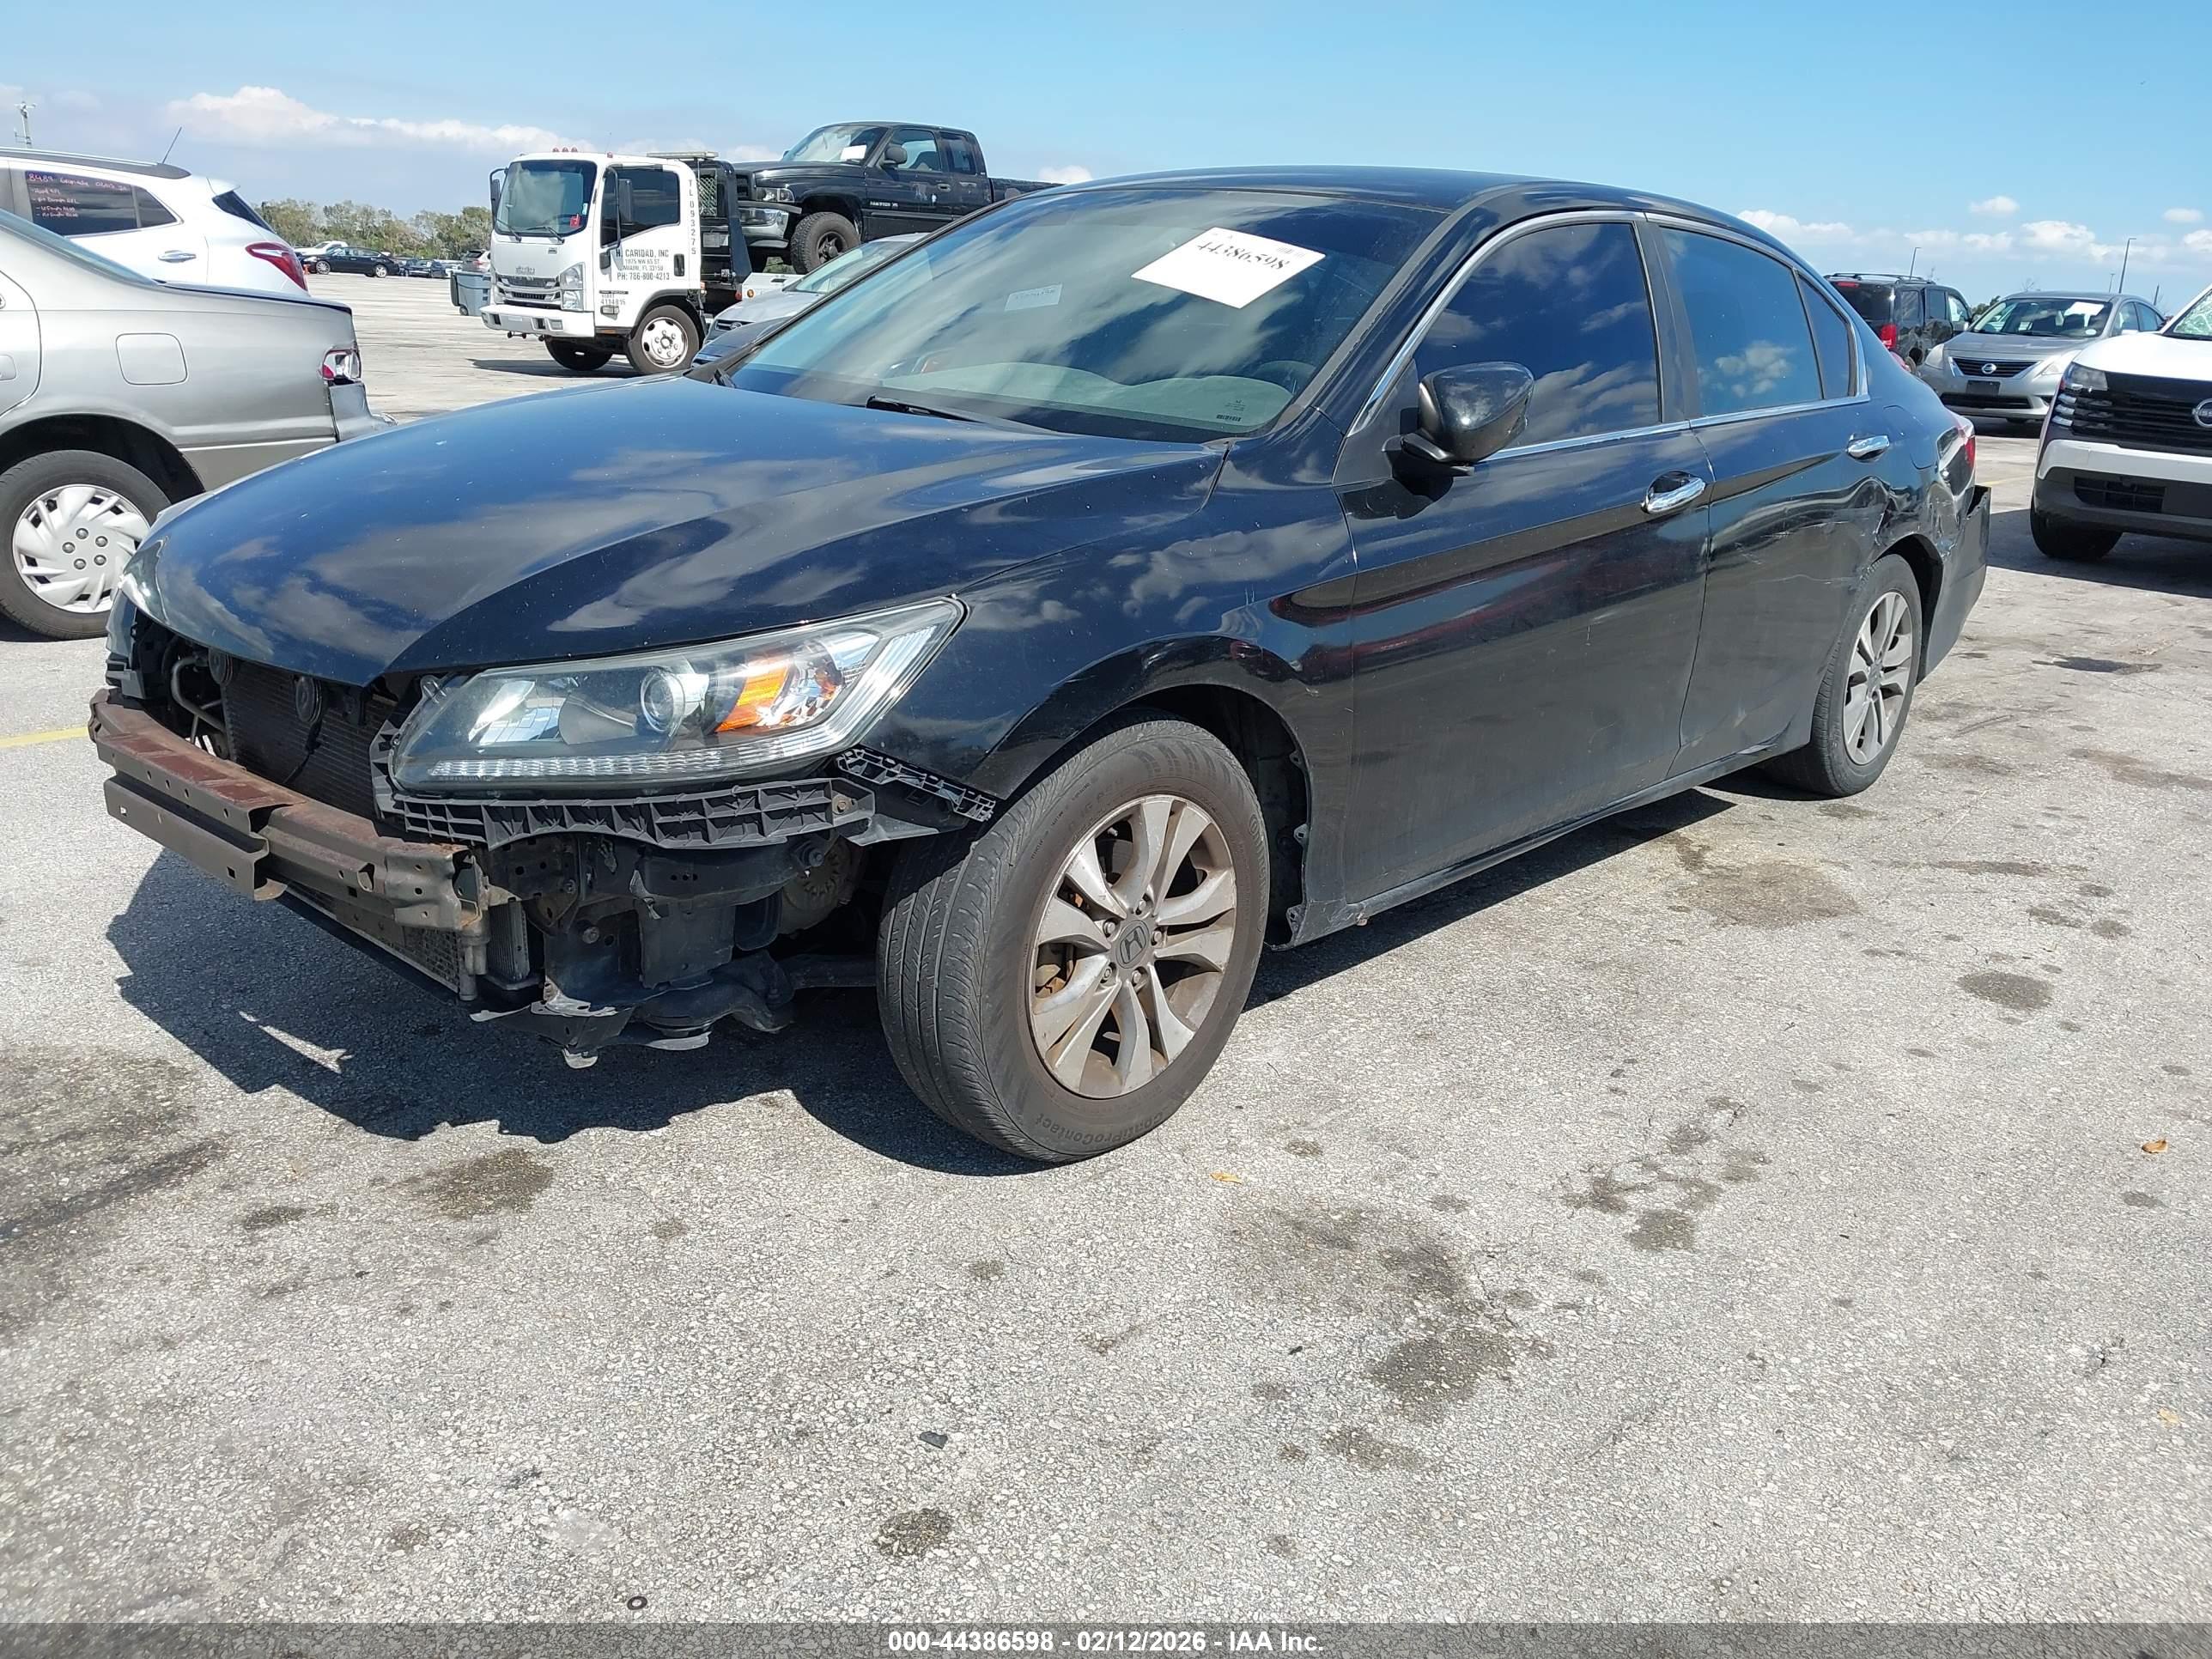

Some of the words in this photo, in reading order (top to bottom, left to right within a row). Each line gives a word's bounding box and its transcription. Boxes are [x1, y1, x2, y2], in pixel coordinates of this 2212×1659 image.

[658, 249, 669, 258] INC
[1197, 241, 1291, 270] 44386598
[617, 272, 628, 281] PH:
